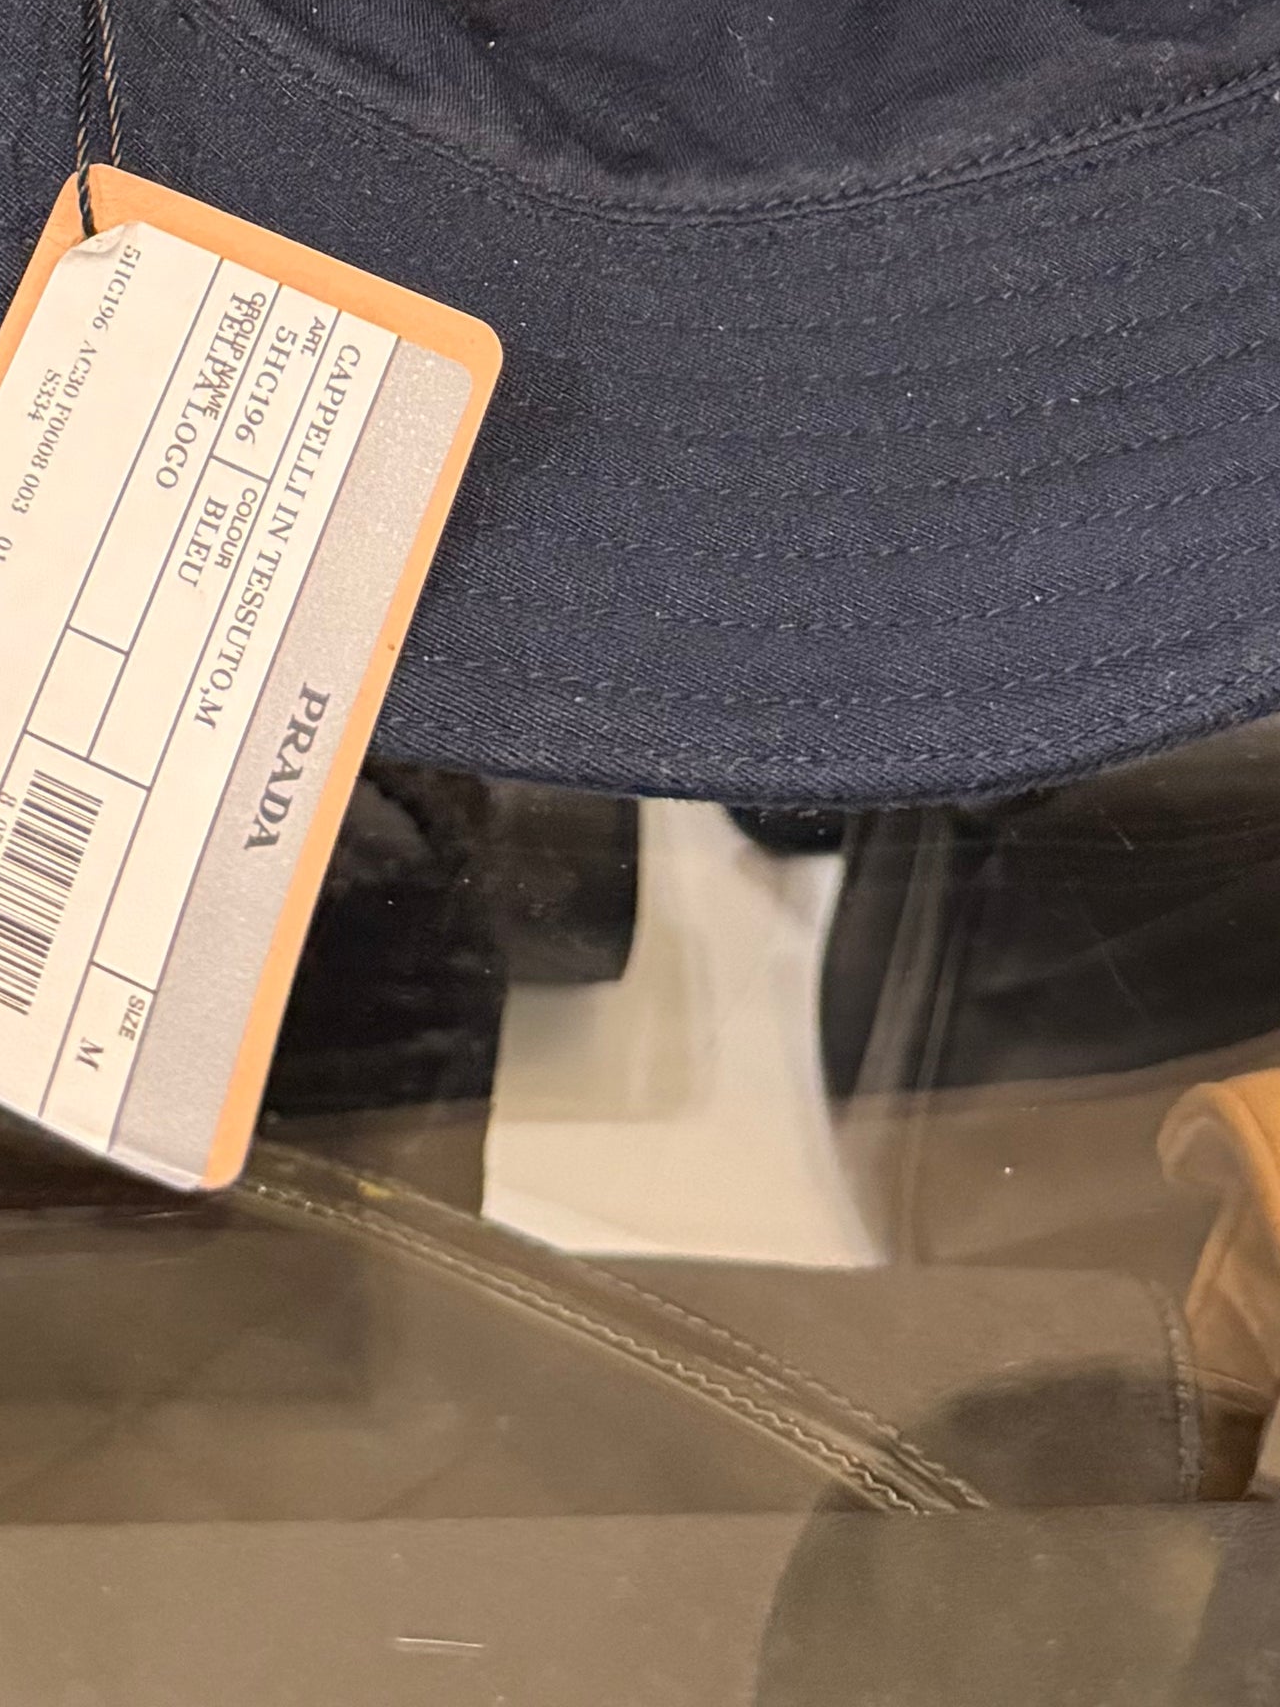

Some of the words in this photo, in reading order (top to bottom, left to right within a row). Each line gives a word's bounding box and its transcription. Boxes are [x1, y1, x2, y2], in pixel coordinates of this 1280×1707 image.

[91, 243, 142, 331] 5HC196
[191, 291, 255, 400] FELPA
[229, 291, 267, 361] GROUP
[299, 314, 327, 357] ART.
[26, 367, 62, 421] S334
[62, 338, 98, 399] AC30
[201, 360, 238, 421] NAME
[233, 324, 299, 445] 5HC196
[30, 401, 73, 470] F0008
[154, 397, 207, 490] LOGO
[282, 343, 361, 500] CAPPELLI
[10, 472, 41, 514] 003
[213, 486, 259, 570] COLOUR
[266, 501, 299, 544] IN
[176, 495, 229, 588] BLEU
[192, 549, 282, 730] TESSUTO,M
[242, 680, 331, 851] PRADA
[117, 994, 146, 1041] SIZE
[75, 1037, 104, 1071] M
